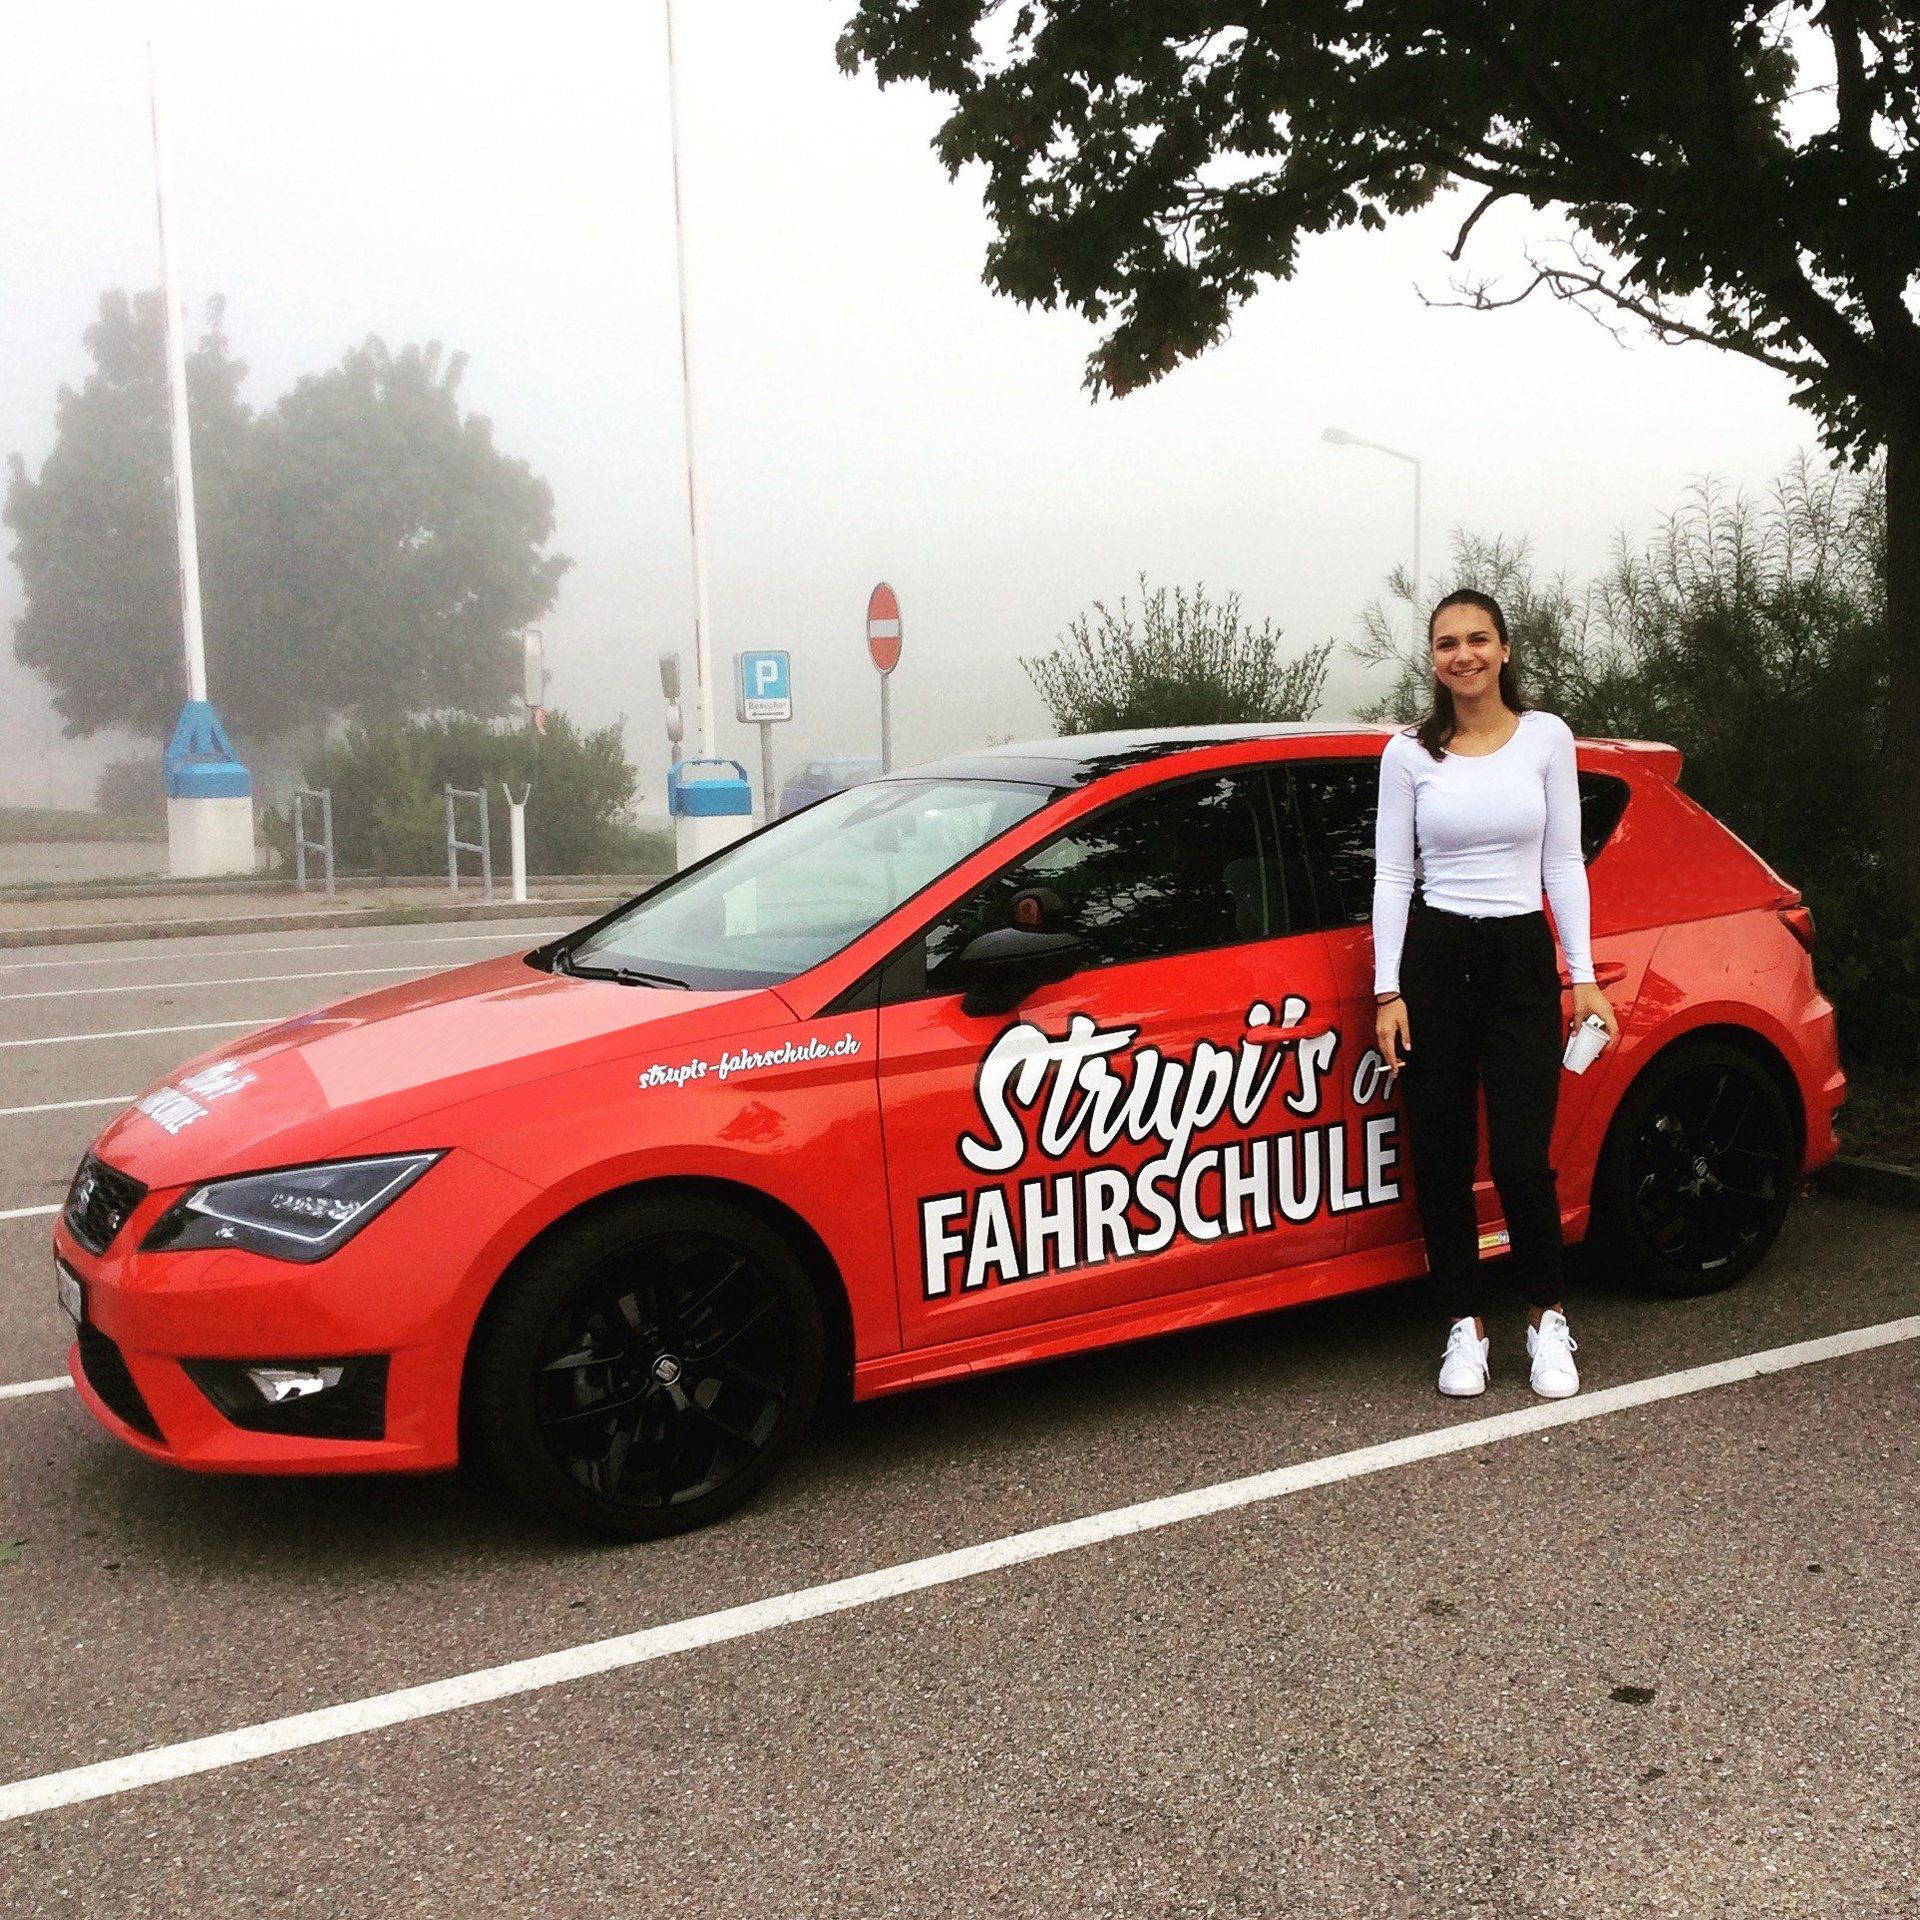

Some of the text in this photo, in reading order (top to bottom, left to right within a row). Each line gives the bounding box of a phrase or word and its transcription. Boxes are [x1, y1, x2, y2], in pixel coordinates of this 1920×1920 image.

[755, 660, 779, 696] P
[638, 1032, 862, 1089] strupis-fahrschule.ch
[960, 996, 1338, 1178] Strupi's
[922, 1116, 1400, 1296] FAHRSCHULE
